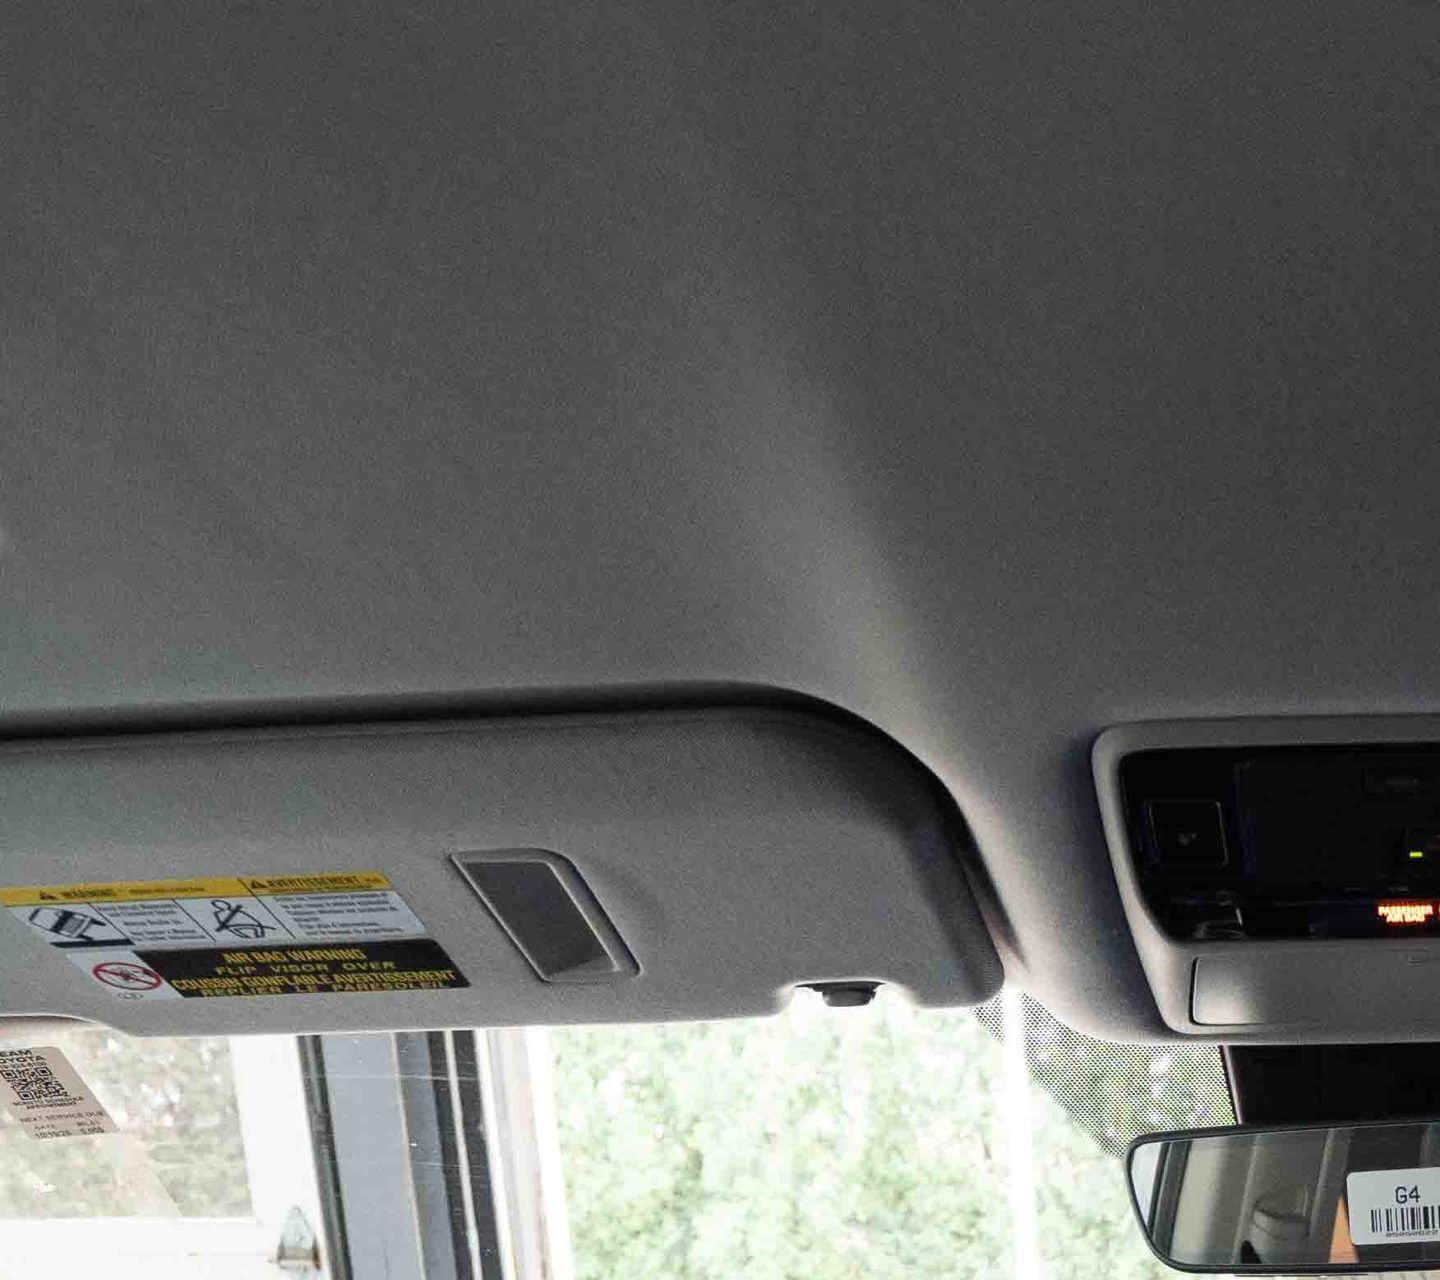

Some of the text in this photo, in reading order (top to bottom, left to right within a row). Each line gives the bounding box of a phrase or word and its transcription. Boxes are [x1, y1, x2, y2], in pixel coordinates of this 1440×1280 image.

[287, 948, 367, 962] WARNING
[269, 963, 329, 974] VISOR
[341, 961, 396, 972] OVER
[1395, 1186, 1421, 1204] G4
